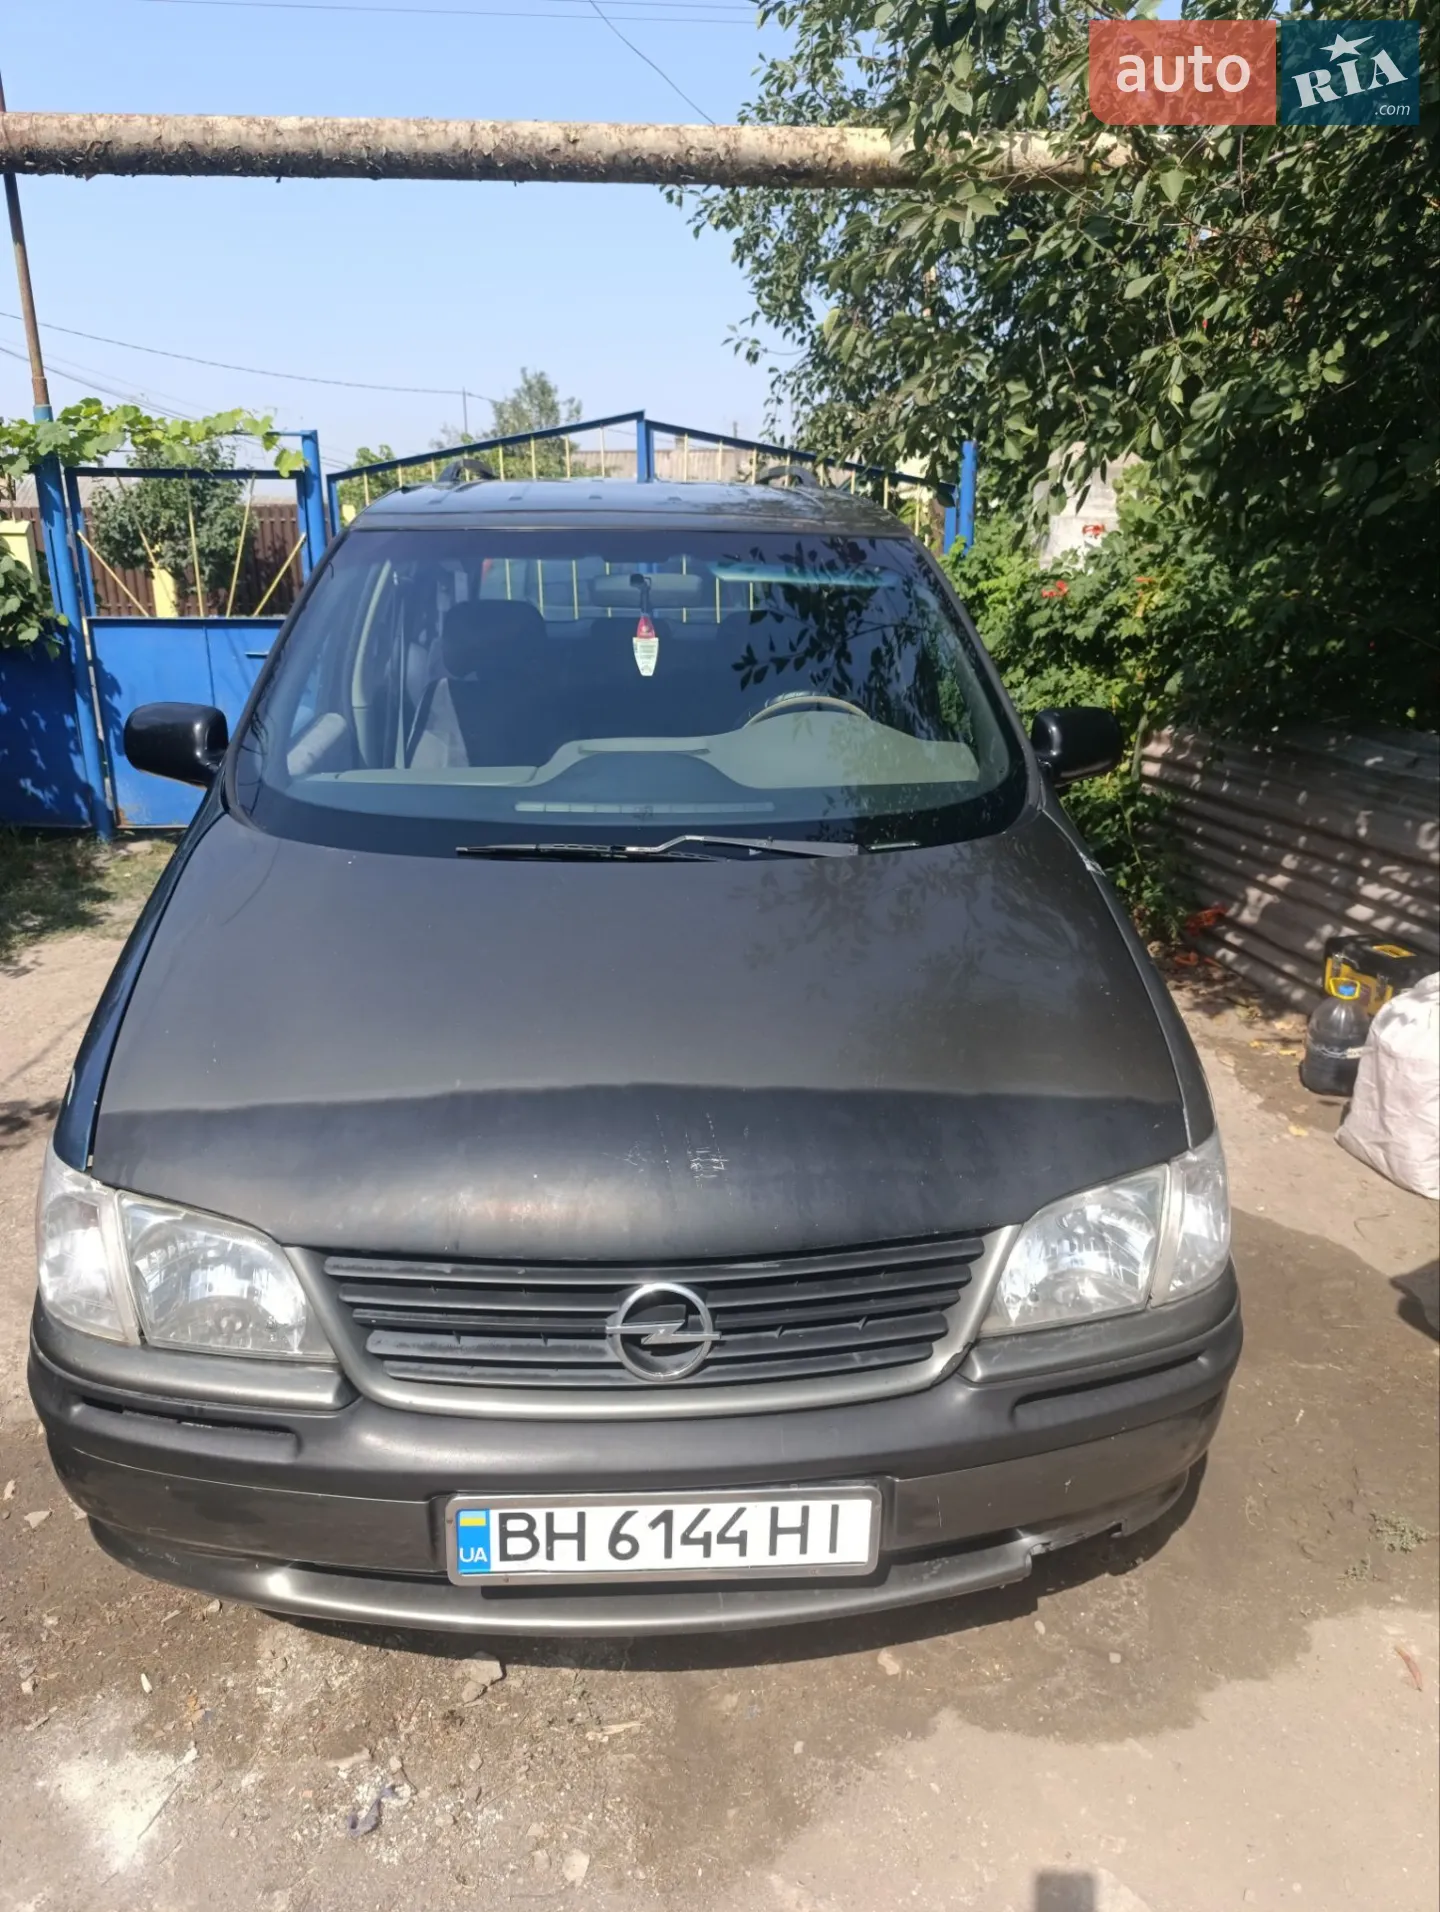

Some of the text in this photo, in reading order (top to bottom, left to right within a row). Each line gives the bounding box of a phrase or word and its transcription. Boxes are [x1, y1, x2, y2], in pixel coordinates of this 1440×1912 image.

[498, 1504, 840, 1562] BH 6144 HI
[459, 1547, 488, 1563] UA
